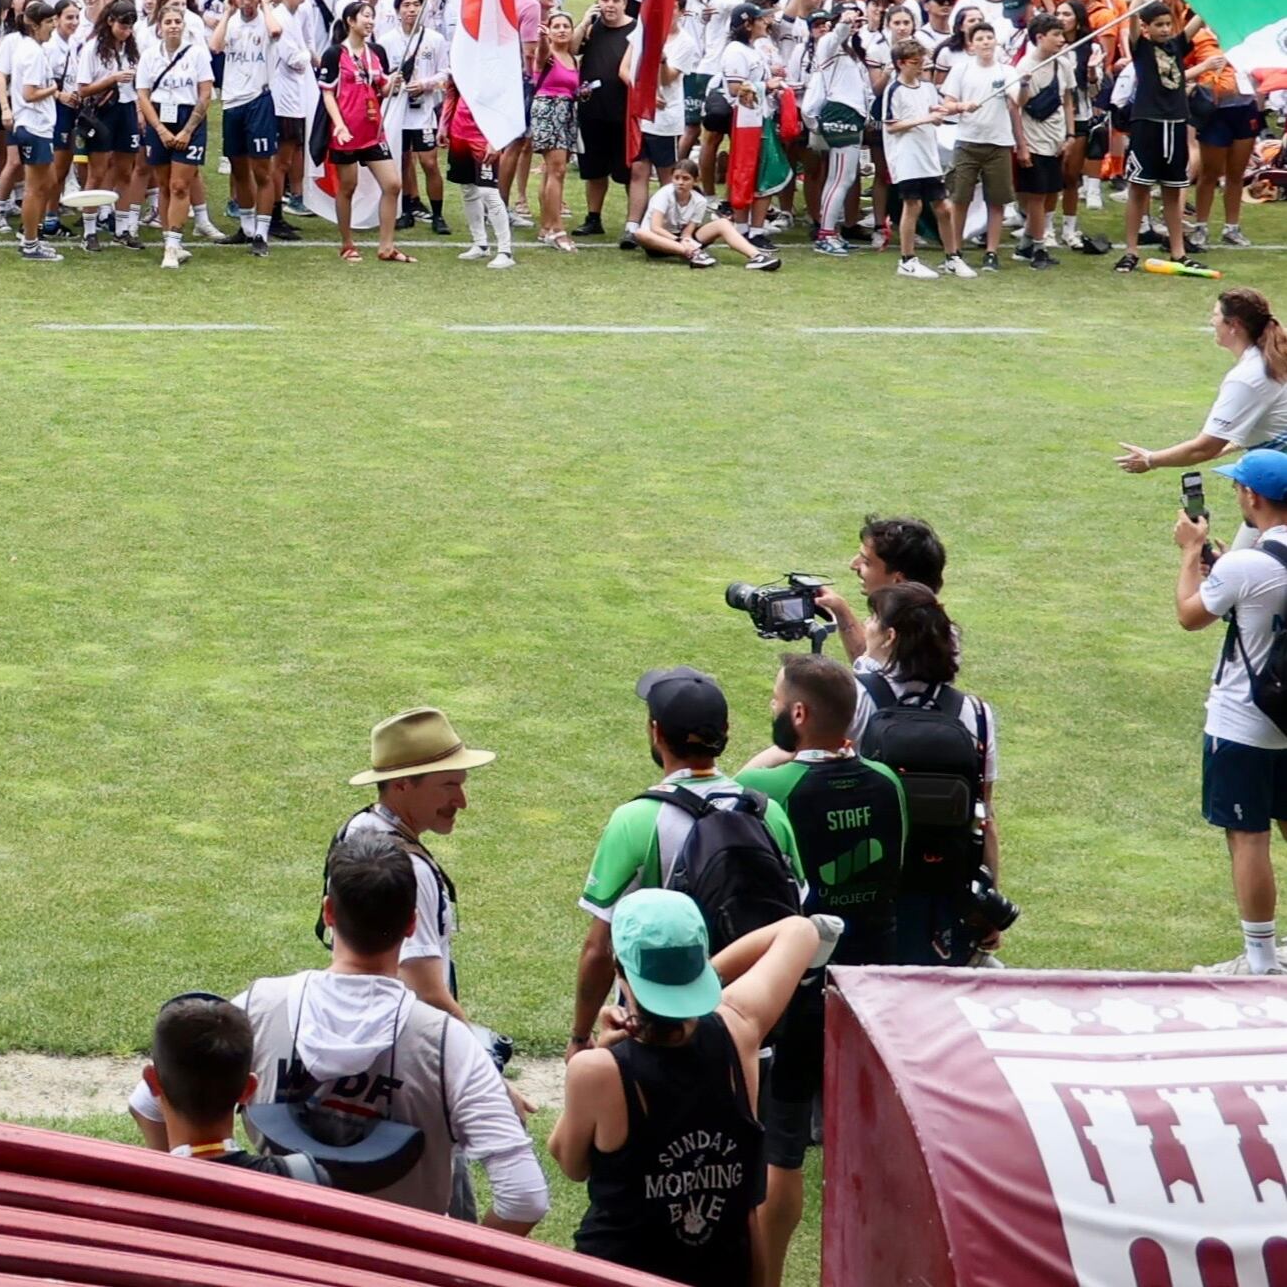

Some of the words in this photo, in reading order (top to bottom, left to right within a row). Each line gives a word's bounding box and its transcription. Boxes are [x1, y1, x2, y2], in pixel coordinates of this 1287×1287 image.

[227, 51, 266, 63] ITALIA
[253, 138, 269, 153] 11
[826, 806, 872, 831] STAFF
[830, 891, 877, 906] ROJECT
[658, 1130, 737, 1168] SUNDAY
[644, 1162, 743, 1199] MORNING
